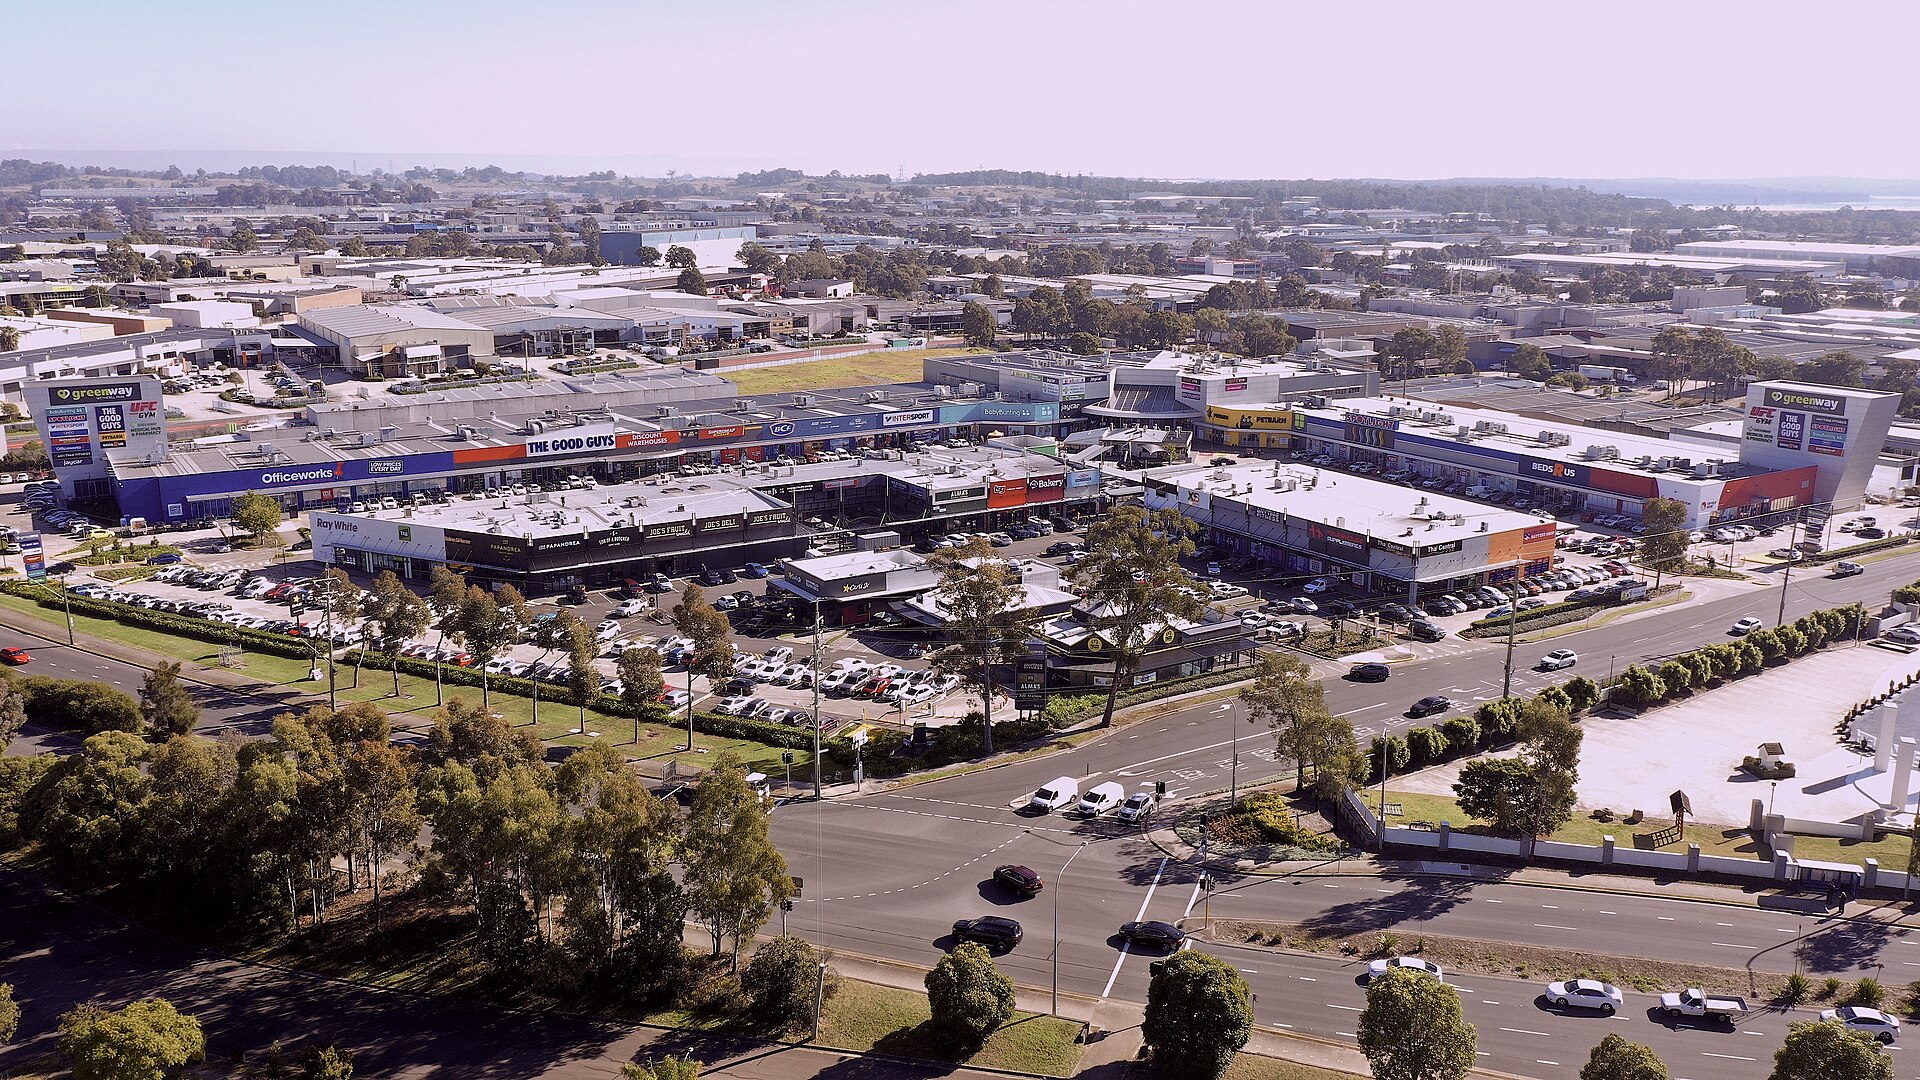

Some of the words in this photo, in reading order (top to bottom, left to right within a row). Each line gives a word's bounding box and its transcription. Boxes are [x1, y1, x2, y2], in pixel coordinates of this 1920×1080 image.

[72, 386, 133, 401] greenway
[130, 401, 158, 412] UFC
[1783, 394, 1838, 410] greenway
[892, 412, 930, 422] INTERSPORT
[1750, 406, 1776, 418] UFC
[1256, 416, 1287, 424] PETBARN
[1346, 414, 1394, 429] SPOTLIGHT
[1755, 417, 1772, 425] GYM
[1785, 414, 1798, 422] THE
[101, 422, 122, 430] GUYS
[774, 424, 792, 433] BCF
[1781, 422, 1800, 430] GOOD
[632, 432, 662, 440] DISCOUNT
[1781, 430, 1799, 438] GUYS
[528, 440, 549, 454] THE
[552, 438, 584, 452] GOOD
[586, 434, 614, 448] GUYS
[627, 438, 668, 447] WAREHOUSES
[1532, 462, 1554, 474] BEDS
[261, 467, 334, 485] Officeworks
[1038, 478, 1064, 488] Bakery
[1188, 490, 1200, 502] XS
[753, 515, 768, 523] JOE'S
[768, 512, 787, 521] FRUIT
[316, 518, 333, 531] Ray
[334, 520, 358, 533] White
[704, 520, 720, 529] JOE'S
[722, 518, 736, 527] DELI
[650, 527, 666, 536] JOE'S
[666, 525, 685, 534] FRUIT
[490, 544, 521, 553] PAPANDREA
[546, 540, 580, 549] PAPANDREA
[1326, 536, 1362, 550] SUPPLEMENTS
[1387, 543, 1404, 552] Central
[1428, 545, 1438, 553] Thai
[1438, 542, 1456, 551] Central
